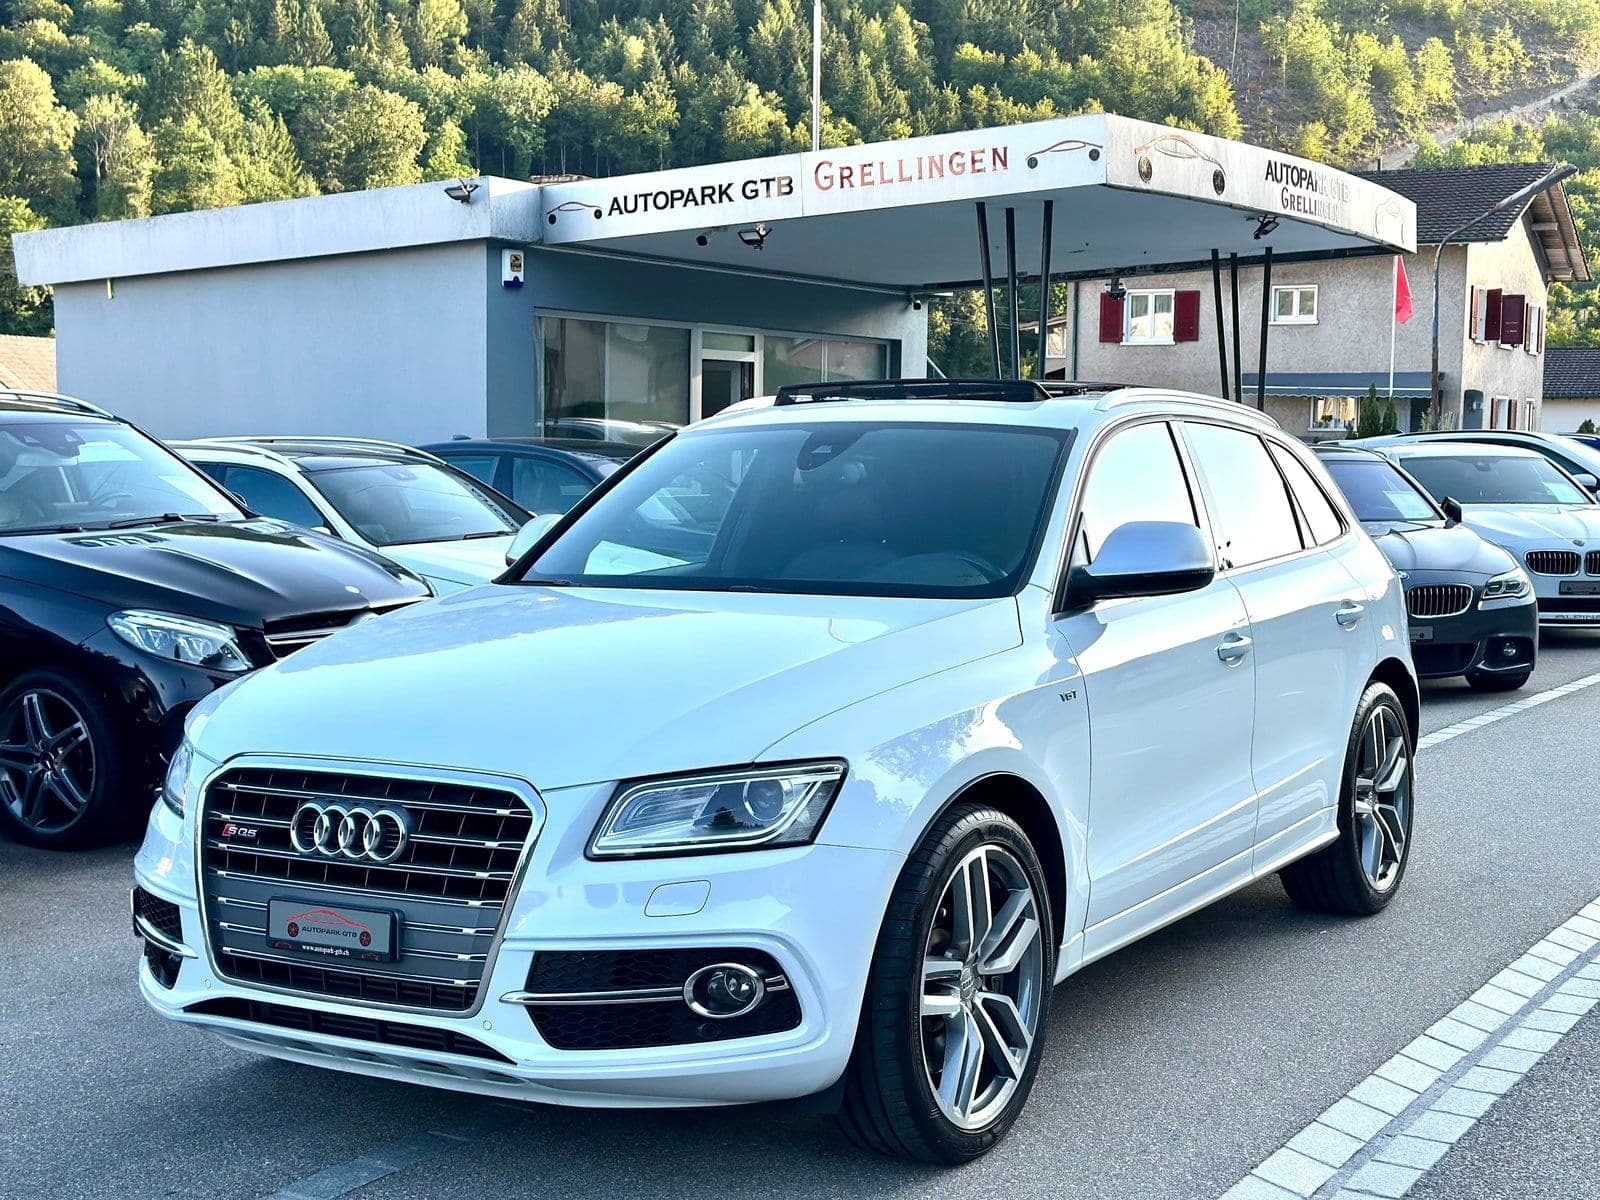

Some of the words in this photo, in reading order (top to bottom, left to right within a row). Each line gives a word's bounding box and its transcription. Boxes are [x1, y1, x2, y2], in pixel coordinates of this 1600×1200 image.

[608, 182, 734, 216] AUTOPARK
[741, 176, 793, 200] GTB
[814, 146, 1009, 191] GRELLINGEN
[1265, 160, 1328, 197] AUTOPARK
[225, 825, 257, 837] SQ5
